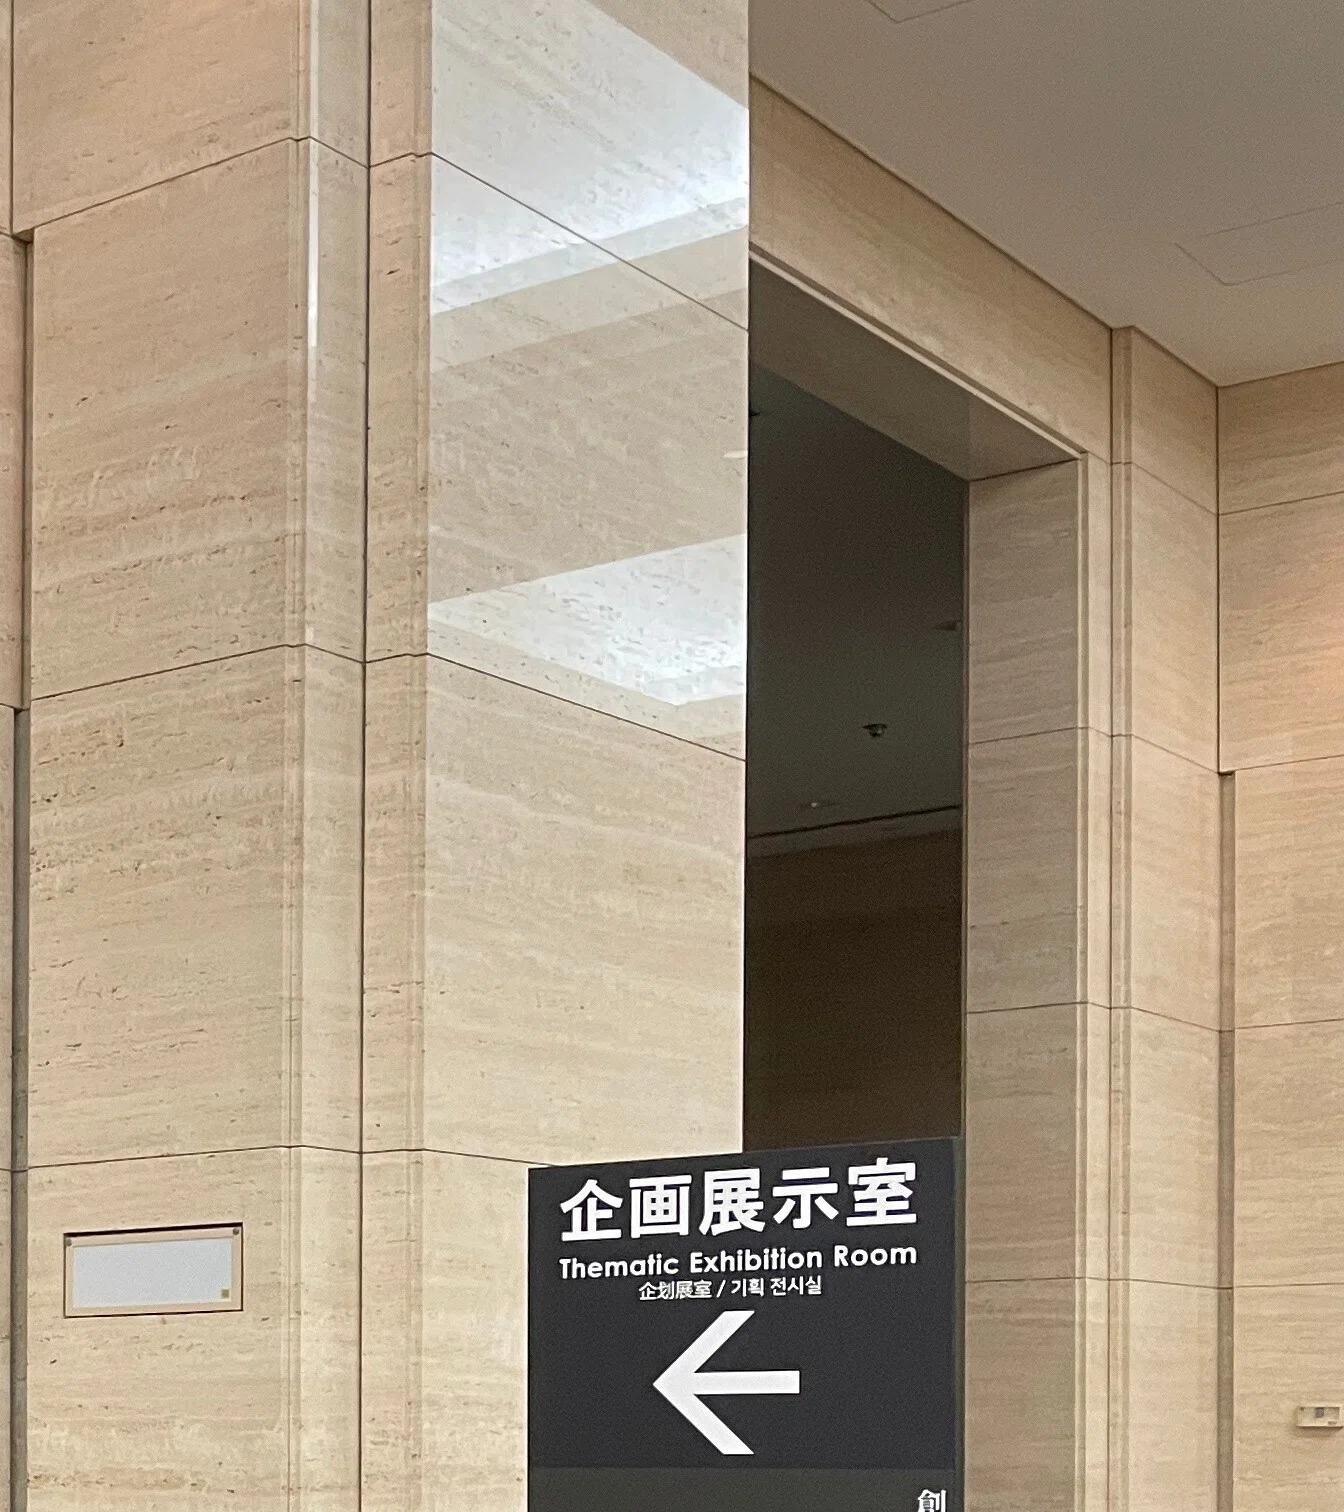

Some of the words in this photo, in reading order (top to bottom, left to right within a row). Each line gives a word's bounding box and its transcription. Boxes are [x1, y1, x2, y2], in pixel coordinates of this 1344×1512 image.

[559, 1157, 918, 1242] 企画展示室
[559, 1253, 680, 1280] Thematic
[690, 1249, 823, 1275] Exhibition
[834, 1245, 918, 1268] Room
[638, 1279, 713, 1301] 企划展室
[730, 1277, 765, 1297] 기획
[770, 1275, 823, 1297] 전시실
